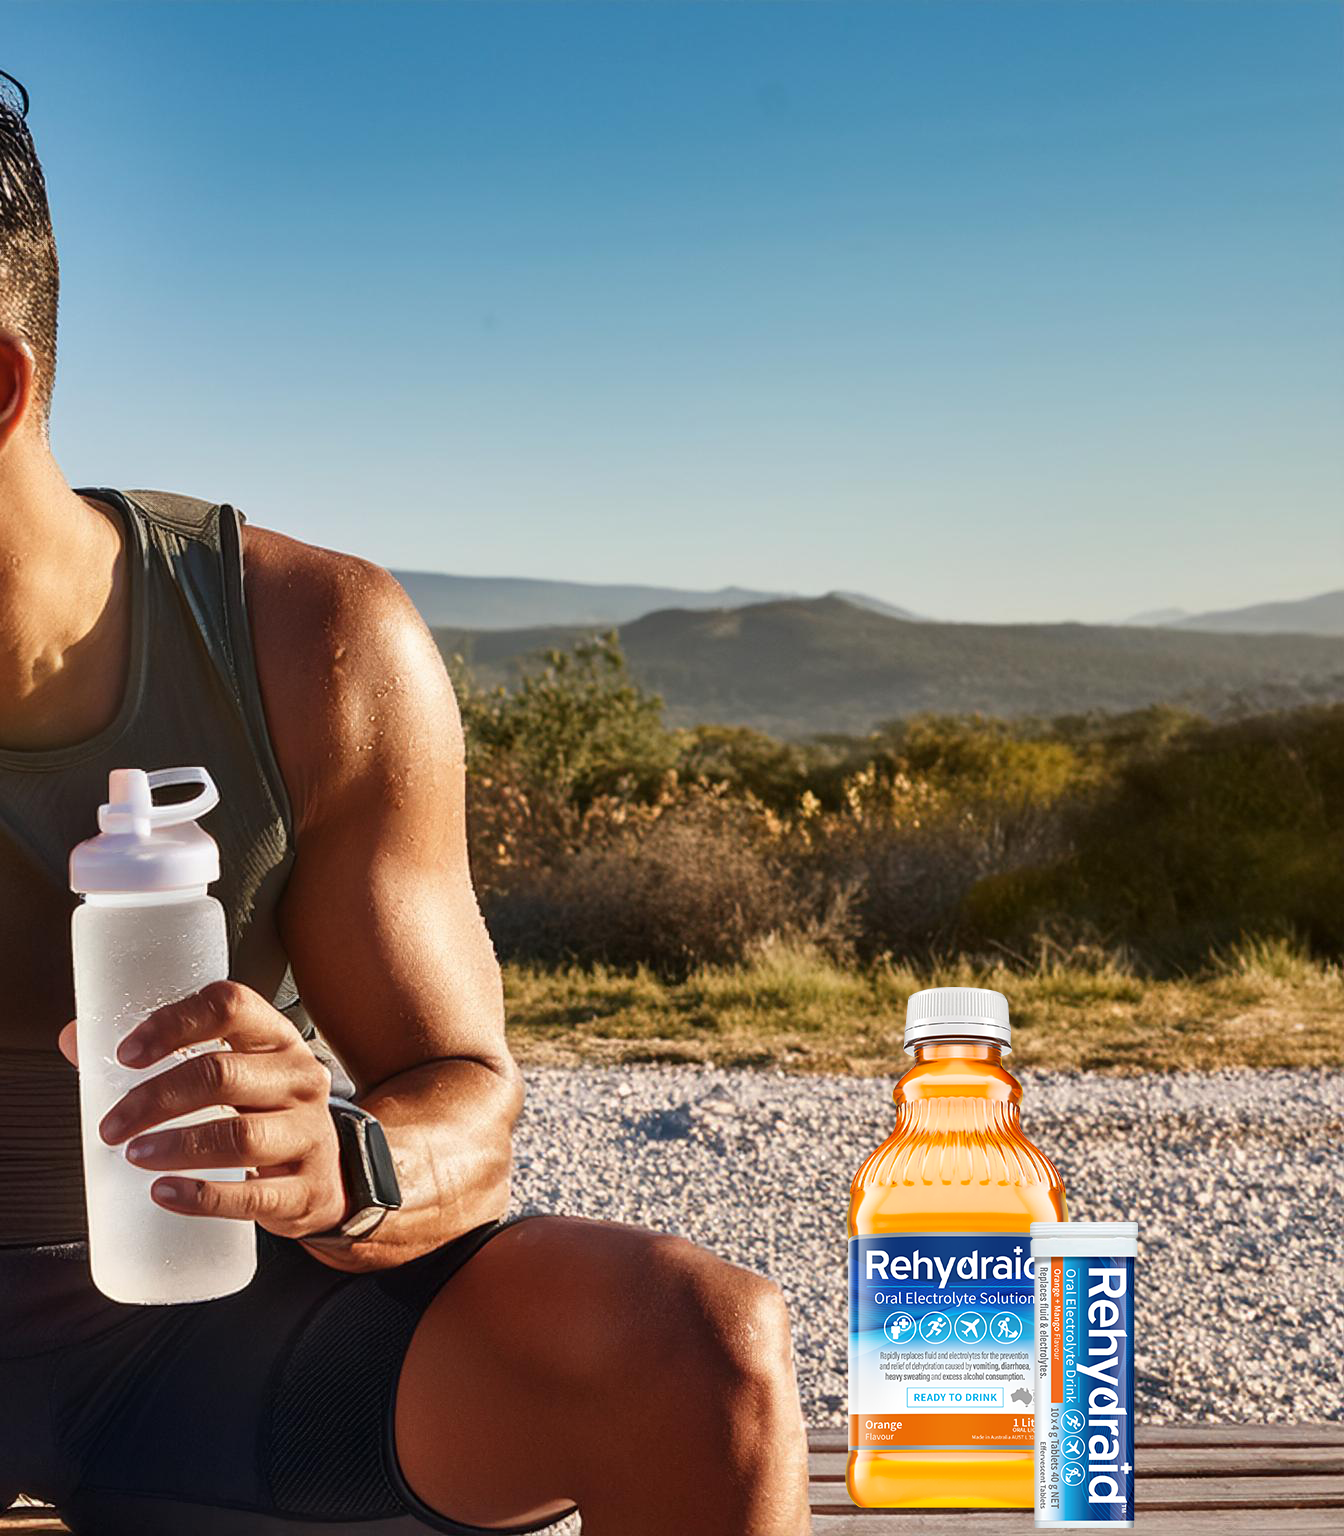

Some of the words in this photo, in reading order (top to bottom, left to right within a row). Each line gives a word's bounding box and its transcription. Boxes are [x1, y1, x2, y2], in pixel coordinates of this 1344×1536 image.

[1038, 1267, 1048, 1301] Replaces
[1052, 1269, 1061, 1297] Orange
[1066, 1269, 1076, 1294] Oral
[874, 1292, 902, 1304] Oral
[907, 1292, 976, 1307] Electrolyte
[980, 1292, 1035, 1304] Solution
[1040, 1304, 1049, 1321] fluid
[1052, 1306, 1061, 1332] Mango
[1063, 1299, 1076, 1366] Electrolyte
[880, 1352, 900, 1361] Rapidly
[901, 1352, 924, 1361] replaces
[925, 1352, 936, 1360] fluid
[938, 1352, 948, 1360] and
[949, 1352, 980, 1361] electrolytes
[990, 1352, 999, 1360] the
[1000, 1352, 1029, 1361] prevention
[1038, 1330, 1049, 1379] electrolytes.
[879, 1362, 890, 1370] and
[891, 1362, 905, 1370] relief
[905, 1362, 911, 1370] of
[912, 1362, 944, 1372] dehydration
[945, 1362, 964, 1370] caused
[965, 1362, 972, 1372] by
[973, 1362, 1000, 1372] vomiting,
[1001, 1362, 1031, 1371] diarrhoea,
[885, 1372, 903, 1382] heavy
[903, 1372, 930, 1382] sweating
[963, 1372, 984, 1380] alcohol
[985, 1372, 1025, 1382] consumption.
[1066, 1370, 1076, 1403] Drink
[914, 1393, 946, 1402] READY
[949, 1393, 962, 1402] TO
[966, 1393, 997, 1402] DRINK
[1051, 1408, 1059, 1417] 10
[865, 1420, 902, 1432] Orange
[1013, 1418, 1019, 1427] 1
[1022, 1417, 1035, 1427] Lit
[1051, 1439, 1060, 1470] Tablets
[1051, 1472, 1059, 1483] 40
[1051, 1492, 1059, 1509] NET
